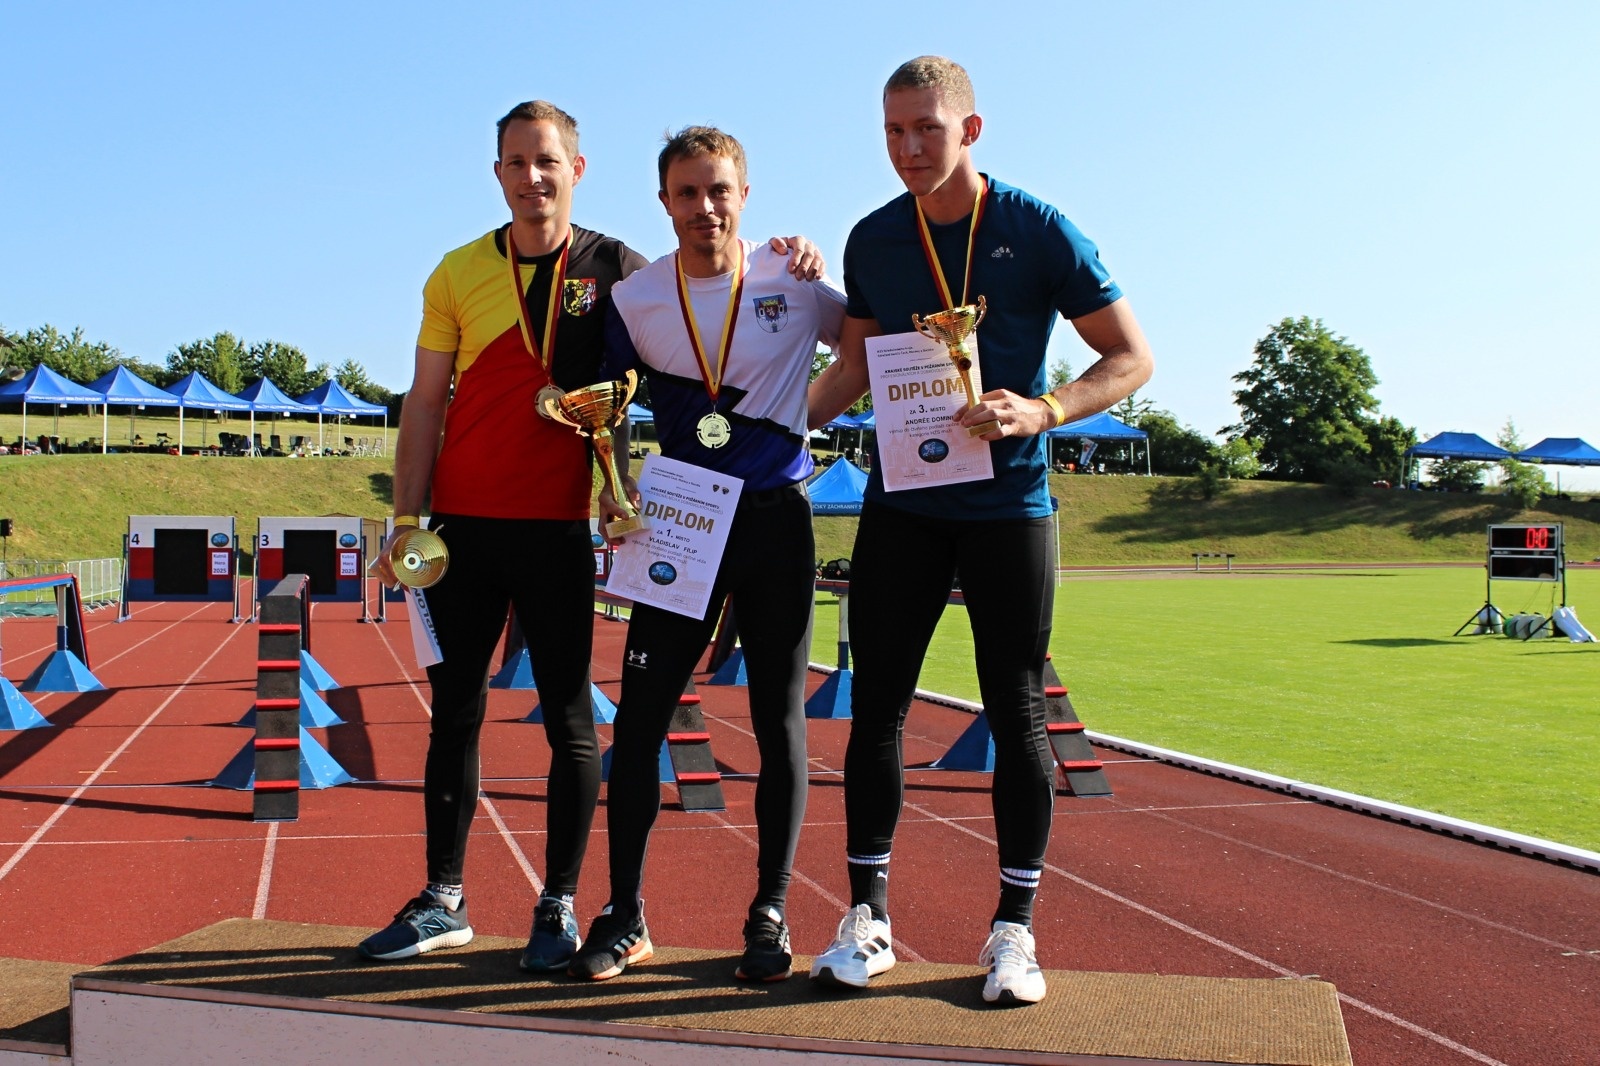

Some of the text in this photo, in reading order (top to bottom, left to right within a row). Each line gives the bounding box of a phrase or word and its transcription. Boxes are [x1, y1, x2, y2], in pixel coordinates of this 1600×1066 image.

[888, 377, 963, 402] DIPLOM
[918, 404, 928, 414] 3.
[644, 500, 714, 534] DIPLOM
[131, 533, 140, 545] 4
[666, 528, 673, 538] 1.
[261, 534, 269, 546] 3
[649, 536, 698, 554] VLADISLAV FILIP
